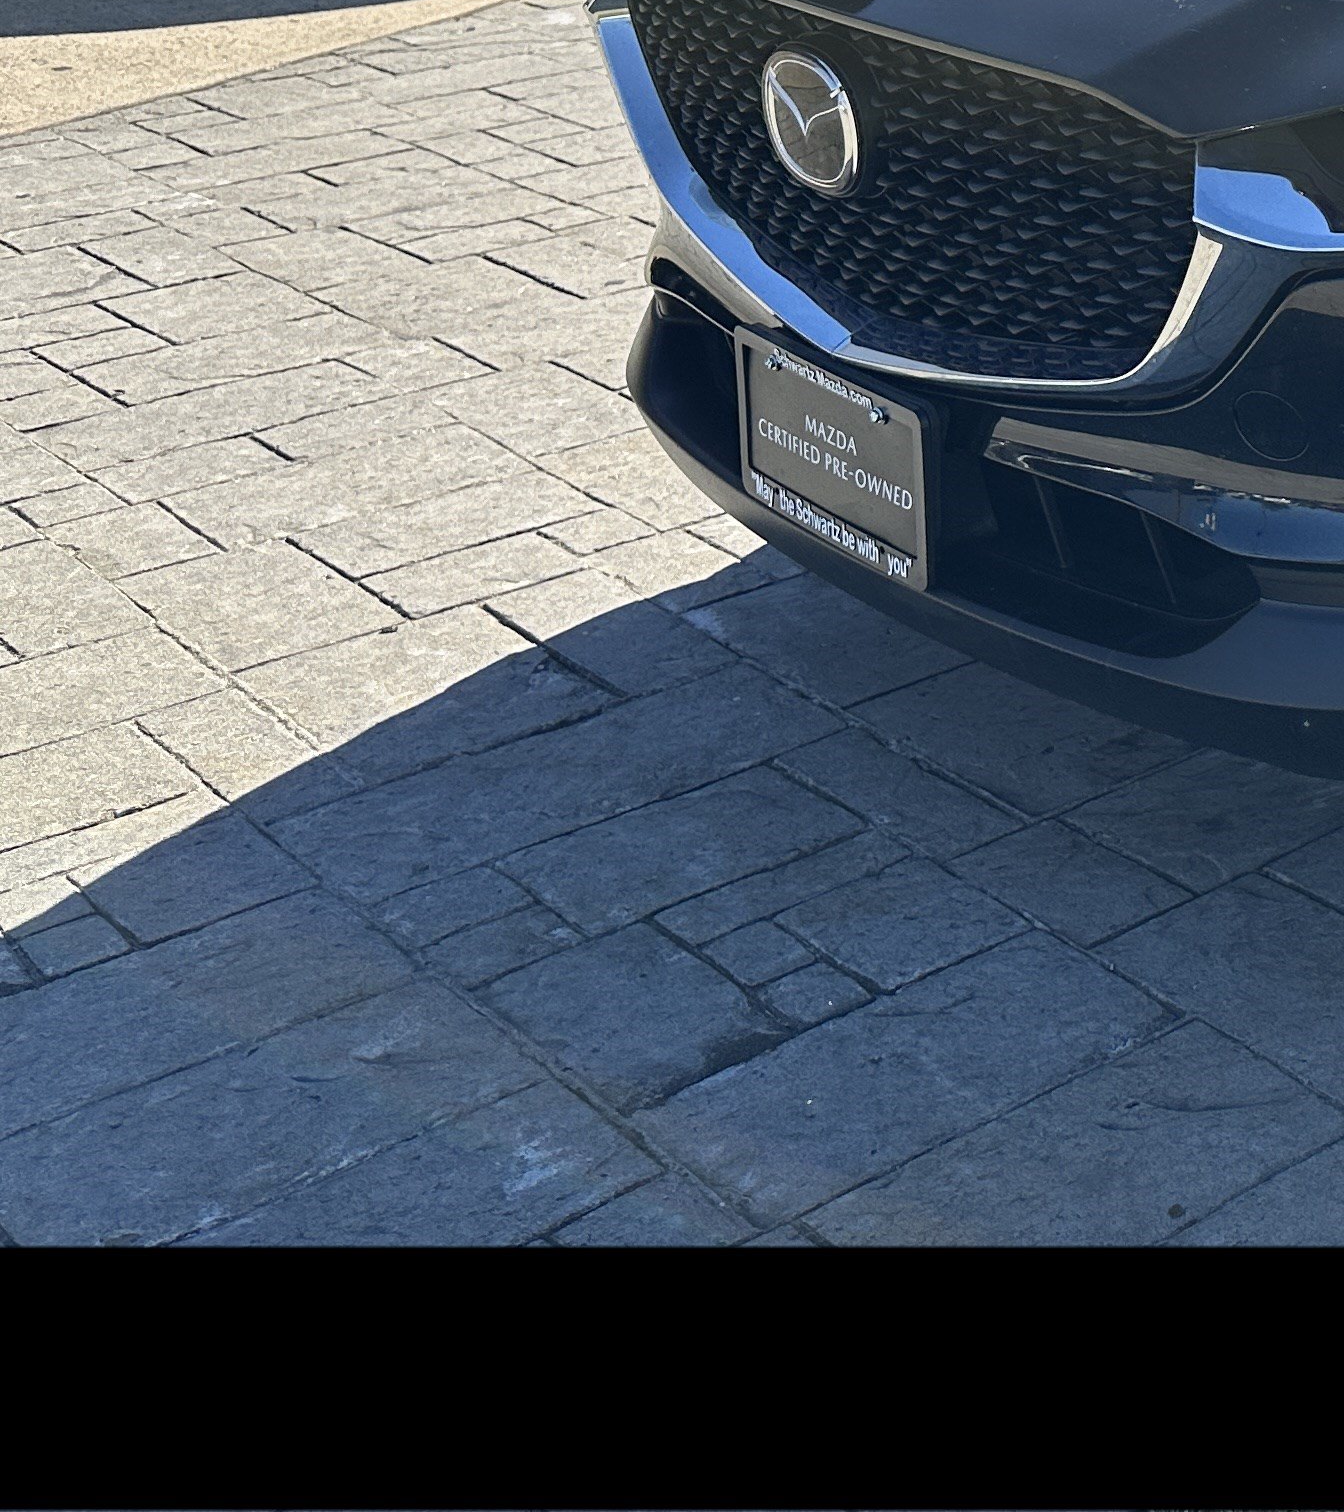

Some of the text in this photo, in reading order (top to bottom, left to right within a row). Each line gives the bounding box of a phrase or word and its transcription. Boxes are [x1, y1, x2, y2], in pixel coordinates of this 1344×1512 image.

[758, 418, 913, 510] CERTIFIED PRE-OWNED
[805, 414, 857, 456] MAZDA
[779, 488, 795, 516] the
[796, 498, 841, 543] Schwartz
[842, 524, 856, 550] be
[856, 535, 880, 564] with
